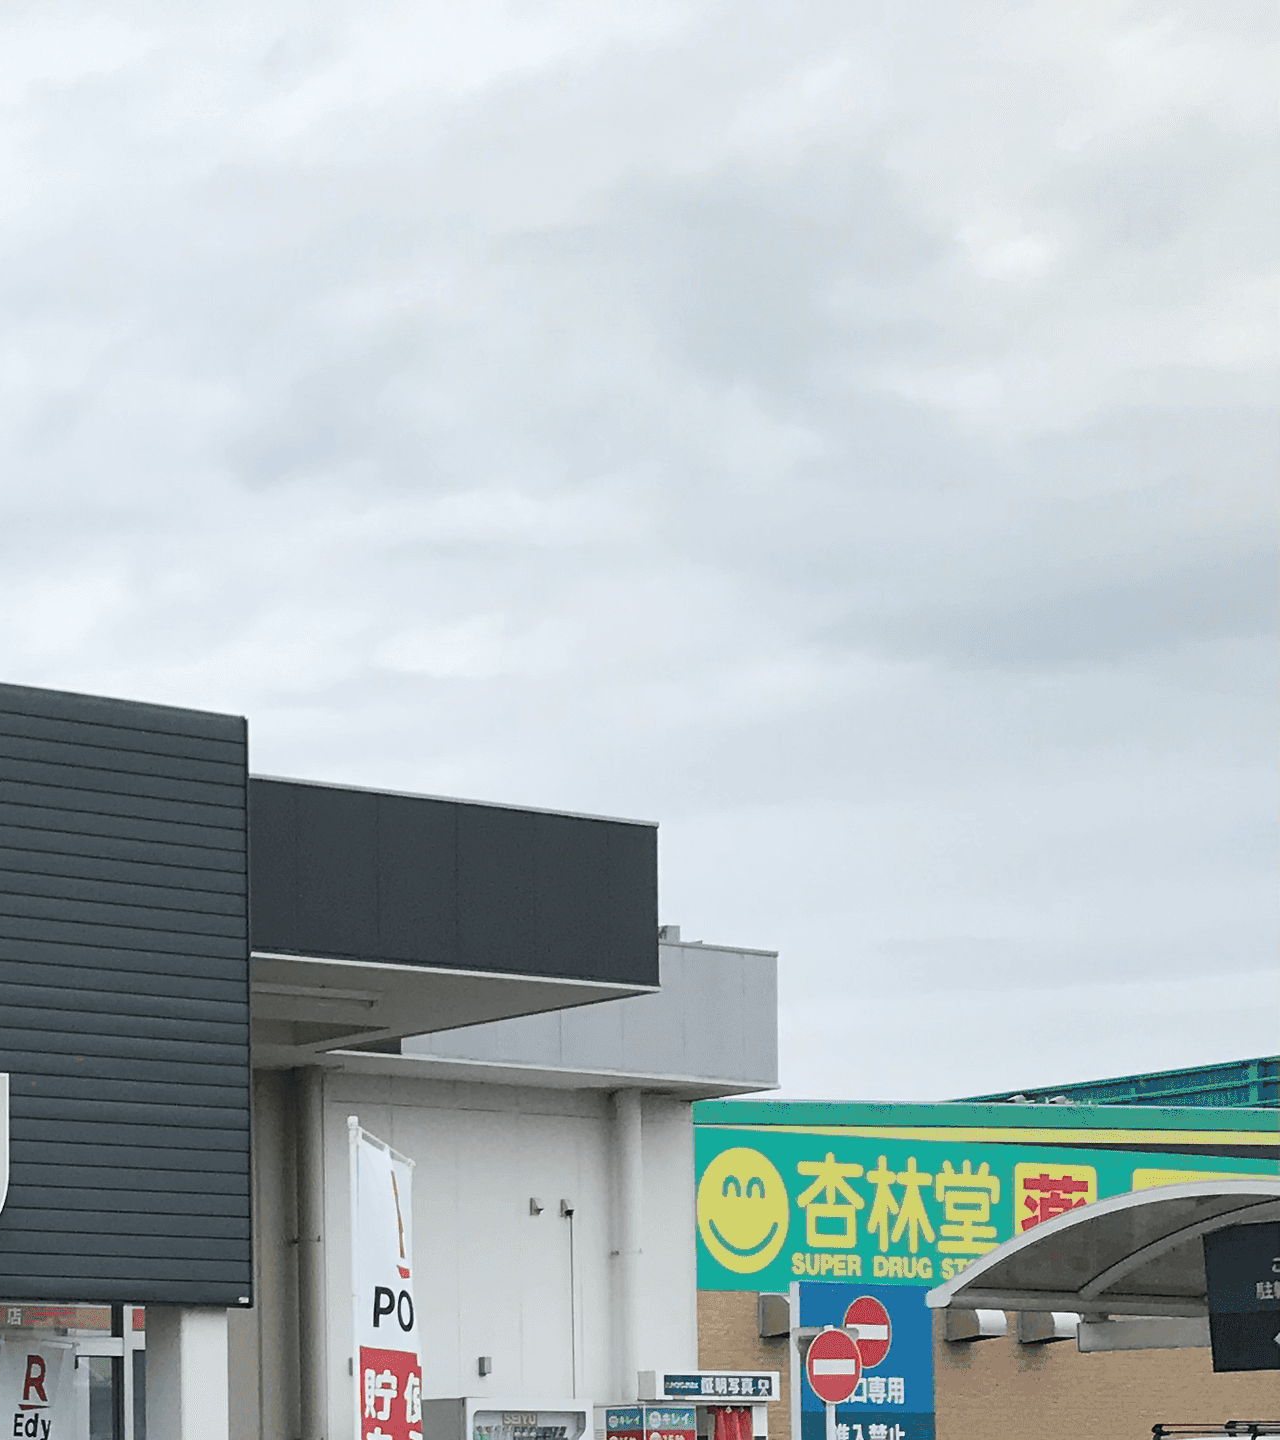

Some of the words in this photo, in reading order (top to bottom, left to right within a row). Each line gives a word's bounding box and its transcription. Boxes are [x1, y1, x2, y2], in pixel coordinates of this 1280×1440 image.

[796, 1152, 1000, 1254] 杏林堂
[791, 1252, 862, 1277] SUPER
[873, 1256, 933, 1279] DRUG
[23, 1355, 48, 1402] R
[701, 1376, 754, 1395] 証明写真
[844, 1376, 905, 1405] 口専用
